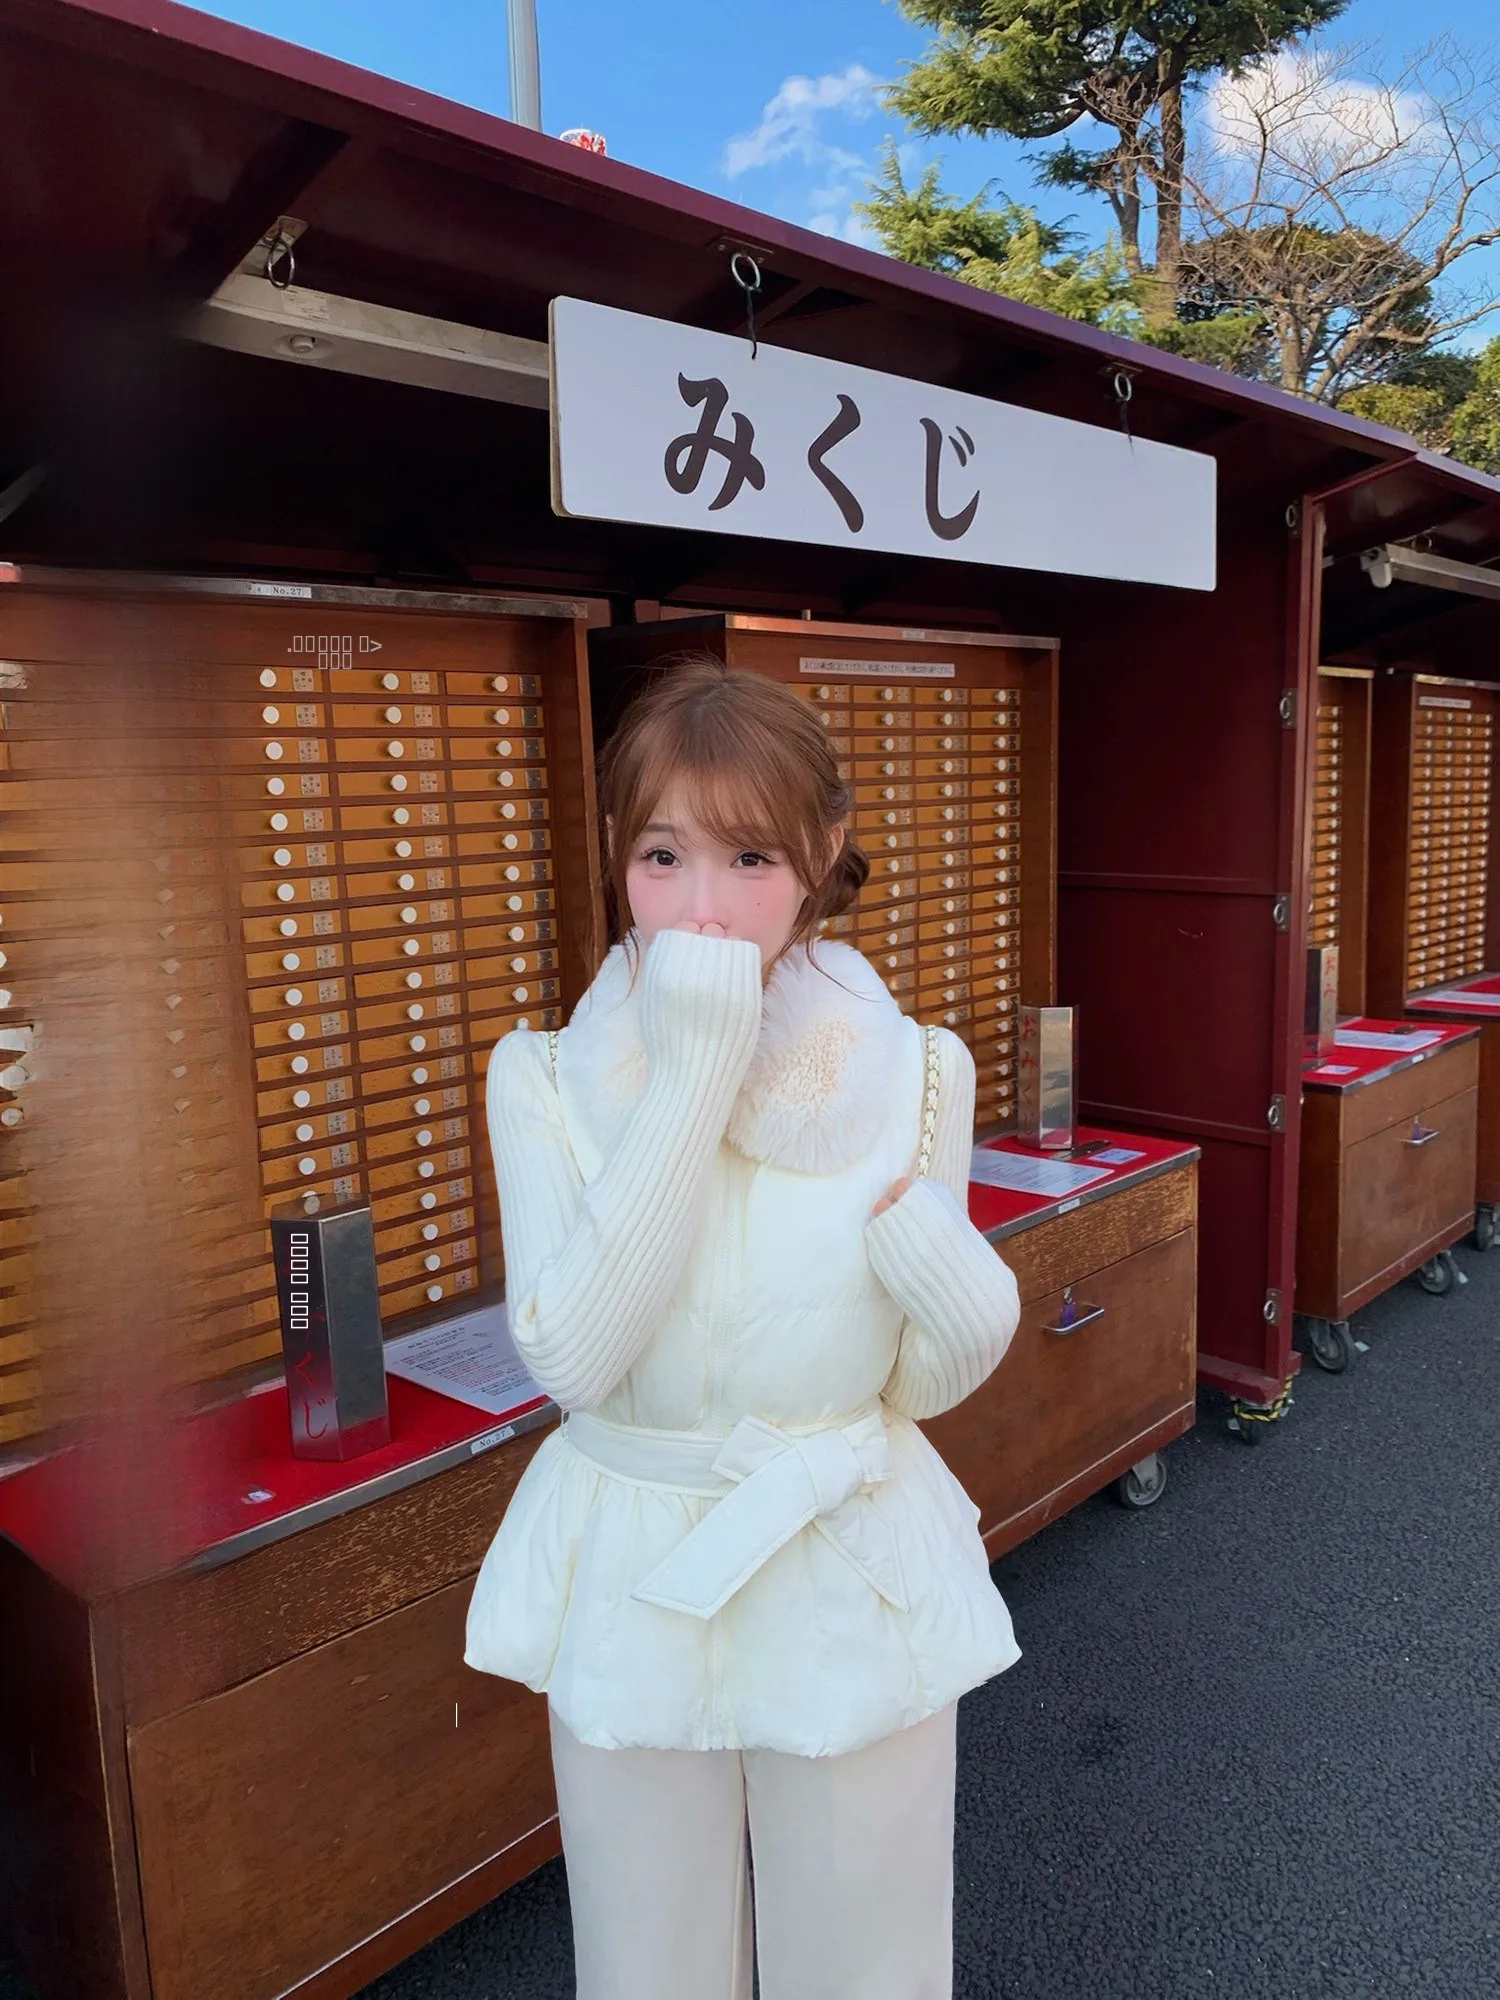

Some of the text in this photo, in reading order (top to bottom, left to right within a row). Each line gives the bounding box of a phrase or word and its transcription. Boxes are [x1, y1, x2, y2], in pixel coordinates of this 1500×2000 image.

[664, 371, 980, 541] みくじ
[273, 587, 302, 596] No.27
